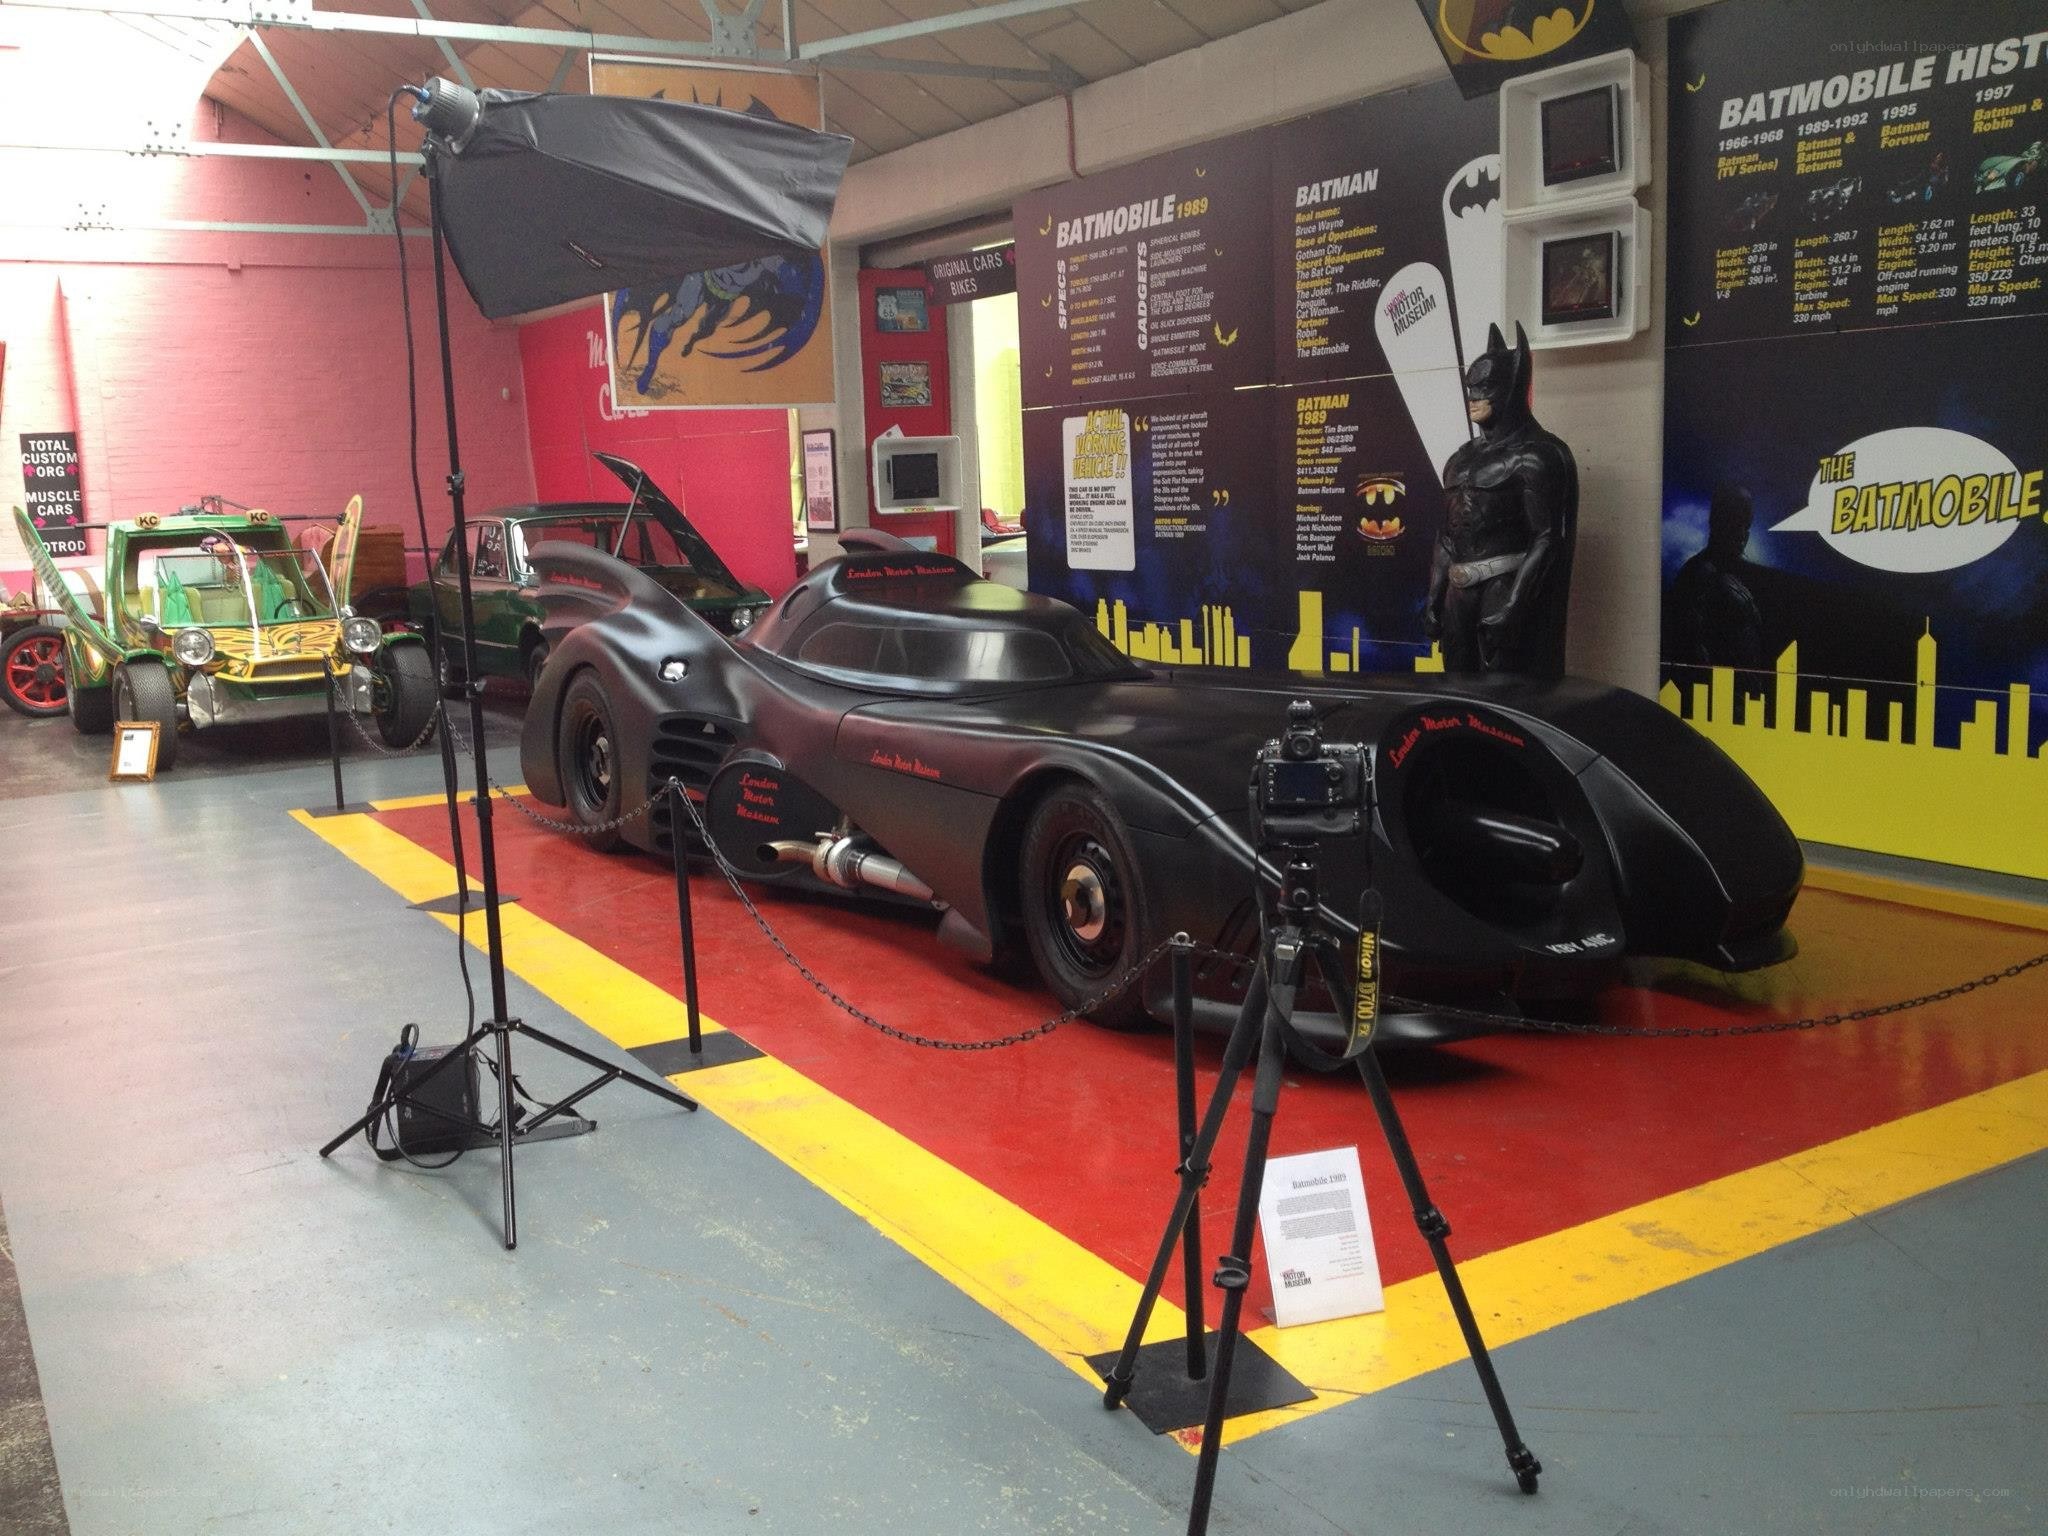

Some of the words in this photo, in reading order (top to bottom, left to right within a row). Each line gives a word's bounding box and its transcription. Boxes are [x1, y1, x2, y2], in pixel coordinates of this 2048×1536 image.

[1718, 55, 1937, 130] BATMOBILE
[1945, 31, 2048, 85] HIST
[1975, 84, 2014, 103] 1997
[1881, 103, 1918, 121] 1995
[1972, 103, 2027, 121] Batman
[1797, 112, 1869, 136] 1989-1992
[1880, 120, 1931, 137] Batman
[1972, 117, 2014, 134] Robin
[1718, 129, 1784, 152] 1966-1968
[1796, 137, 1842, 152] Batman
[1880, 132, 1932, 149] Forever
[1717, 153, 1760, 168] Batman
[1796, 148, 1842, 164] Batman
[1717, 166, 1736, 180] (TV
[1738, 158, 1779, 175] Series)
[1796, 159, 1844, 175] Returns
[1295, 169, 1379, 208] BATMAN
[1056, 194, 1177, 249] BATMOBILE
[1177, 196, 1209, 219] 1989
[1969, 208, 2018, 225] Length:
[2020, 205, 2036, 218] 33
[1295, 225, 1316, 237] Bruce
[1319, 219, 1344, 231] Wayne
[1328, 224, 1378, 243] Operations:
[1878, 222, 1918, 237] Length:
[1921, 219, 1942, 231] 7.62
[1944, 218, 1955, 228] m
[1969, 222, 1991, 236] feet
[2027, 217, 2042, 230] 10
[1794, 234, 1831, 248] Length:
[1832, 230, 1858, 243] 260.7
[1878, 234, 1913, 248] Width:
[1915, 231, 1936, 243] 94.4
[1938, 230, 1948, 240] in
[1969, 234, 2010, 248] meters
[1295, 247, 1325, 261] Gotham
[1327, 244, 1342, 255] City
[1716, 245, 1750, 259] Length:
[1752, 243, 1767, 253] 230
[1768, 241, 1778, 251] in
[1794, 249, 1803, 258] in
[1877, 246, 1916, 260] Height:
[1918, 242, 1939, 254] 3.20
[1969, 245, 2014, 261] Height:
[2019, 242, 2035, 255] 1.5
[933, 259, 972, 279] ORIGINAL
[973, 252, 1003, 272] CARS
[1716, 256, 1745, 268] Width:
[1747, 254, 1758, 264] 90
[1759, 253, 1768, 263] in
[1794, 256, 1826, 269] Width:
[1828, 254, 1847, 266] 94.4
[1849, 252, 1859, 262] in
[1877, 258, 1917, 271] Engine:
[1968, 259, 2015, 274] Engine:
[1296, 270, 1309, 280] The
[1311, 267, 1324, 278] Bat
[1325, 264, 1344, 275] Cave
[1716, 267, 1748, 280] Height:
[1751, 265, 1762, 275] 48
[1763, 263, 1771, 272] in
[1794, 267, 1830, 280] Height:
[1831, 265, 1851, 276] 51.2
[1852, 264, 1862, 274] in
[1876, 268, 1918, 282] Off-road
[1919, 264, 1959, 277] running
[1968, 271, 1988, 284] 350
[1990, 269, 2013, 282] ZZ3
[950, 278, 978, 296] BIKES
[1296, 289, 1309, 299] The
[1336, 282, 1350, 293] The
[1716, 278, 1745, 290] Engine:
[1748, 276, 1763, 286] 390
[1794, 279, 1831, 292] Engine:
[1832, 276, 1848, 287] Jet
[1876, 281, 1910, 294] engine
[1967, 282, 1994, 295] Max
[1997, 278, 2042, 293] Speed:
[1057, 259, 1068, 331] SPECS
[1137, 241, 1148, 351] GADGETS
[1716, 289, 1731, 300] V-8
[1794, 290, 1828, 302] Turbine
[1876, 293, 1899, 305] Max
[1967, 295, 1987, 308] 329
[1989, 292, 2017, 306] mph
[1389, 286, 1425, 322] MOTOR
[1793, 302, 1814, 313] Max
[1816, 299, 1850, 311] Speed:
[1876, 304, 1899, 316] mph
[1296, 308, 1308, 319] Cat
[1394, 294, 1436, 336] MUSEUM
[1793, 313, 1809, 324] 330
[1810, 311, 1832, 323] mph
[1296, 328, 1317, 339] Robin
[1189, 342, 1207, 352] MODE
[1296, 348, 1310, 358] The
[1311, 343, 1350, 357] Batmobile
[1296, 394, 1350, 412] BATMAN
[1298, 410, 1327, 425] 1989
[1324, 425, 1336, 434] Tim
[1337, 424, 1359, 433] Burton
[28, 440, 70, 452] TOTAL
[1334, 445, 1357, 454] million
[21, 452, 78, 465] CUSTOM
[36, 466, 66, 478] ORG
[1819, 451, 1856, 484] THE
[25, 490, 81, 503] MUSCLE
[1297, 486, 1320, 495] Batman
[1321, 485, 1345, 494] Returns
[36, 504, 74, 516] CARS
[250, 511, 269, 523] KC
[1320, 514, 1343, 522] Keaton
[138, 515, 159, 527] KC
[1296, 524, 1310, 532] Jack
[1311, 524, 1342, 532] Nicholson
[42, 541, 87, 553] OTROD
[847, 568, 882, 579] London
[883, 566, 913, 577] Motor
[914, 564, 957, 575] Museum
[1388, 728, 1421, 769] London
[1420, 716, 1462, 731] Motor
[1467, 713, 1525, 747] Museum
[871, 750, 892, 768] London
[894, 753, 913, 771] Motor
[913, 758, 940, 778] Museum
[738, 773, 778, 790] London
[743, 788, 775, 807] Motor
[736, 803, 780, 825] Museum
[1361, 931, 1375, 979] Nikon
[1357, 981, 1376, 1020] D700
[1292, 1177, 1328, 1190] Batmobile
[1284, 1277, 1312, 1289] MUSEUM
